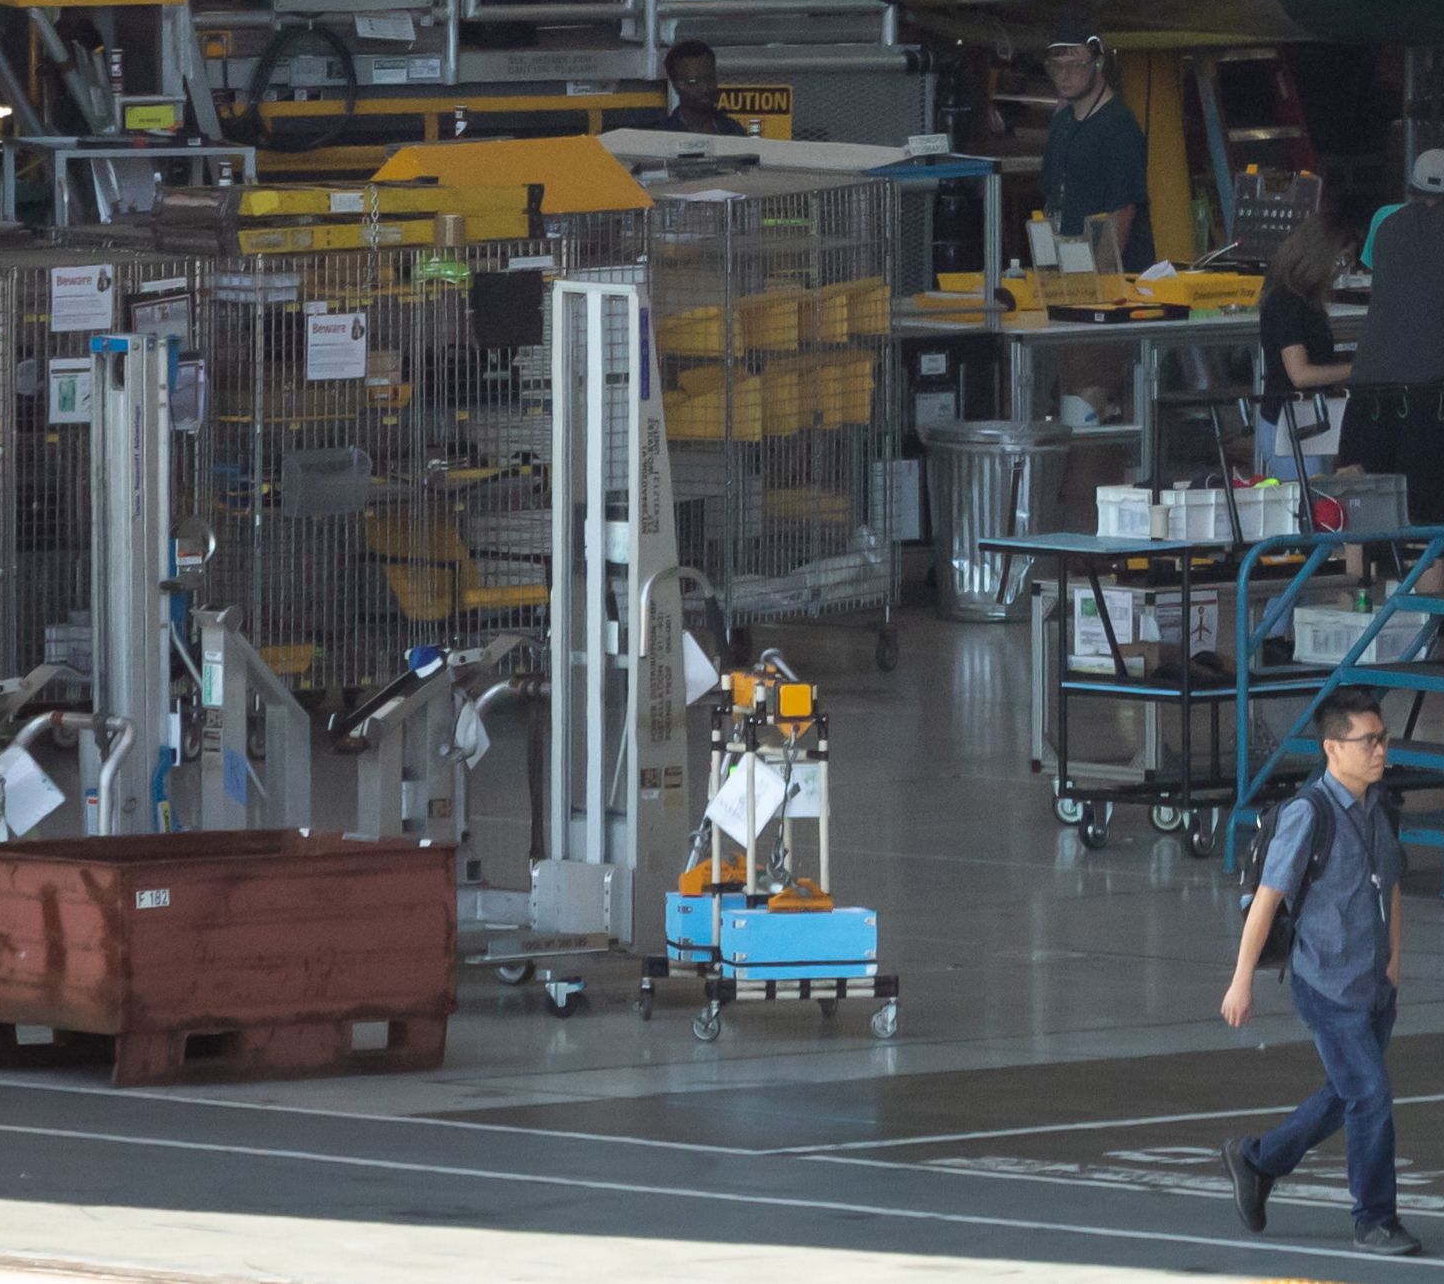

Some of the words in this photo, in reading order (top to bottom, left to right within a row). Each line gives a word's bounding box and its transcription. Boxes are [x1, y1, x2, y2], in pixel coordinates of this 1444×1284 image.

[717, 88, 787, 110] AUTION
[54, 273, 93, 287] Beware
[313, 323, 347, 333] Beware
